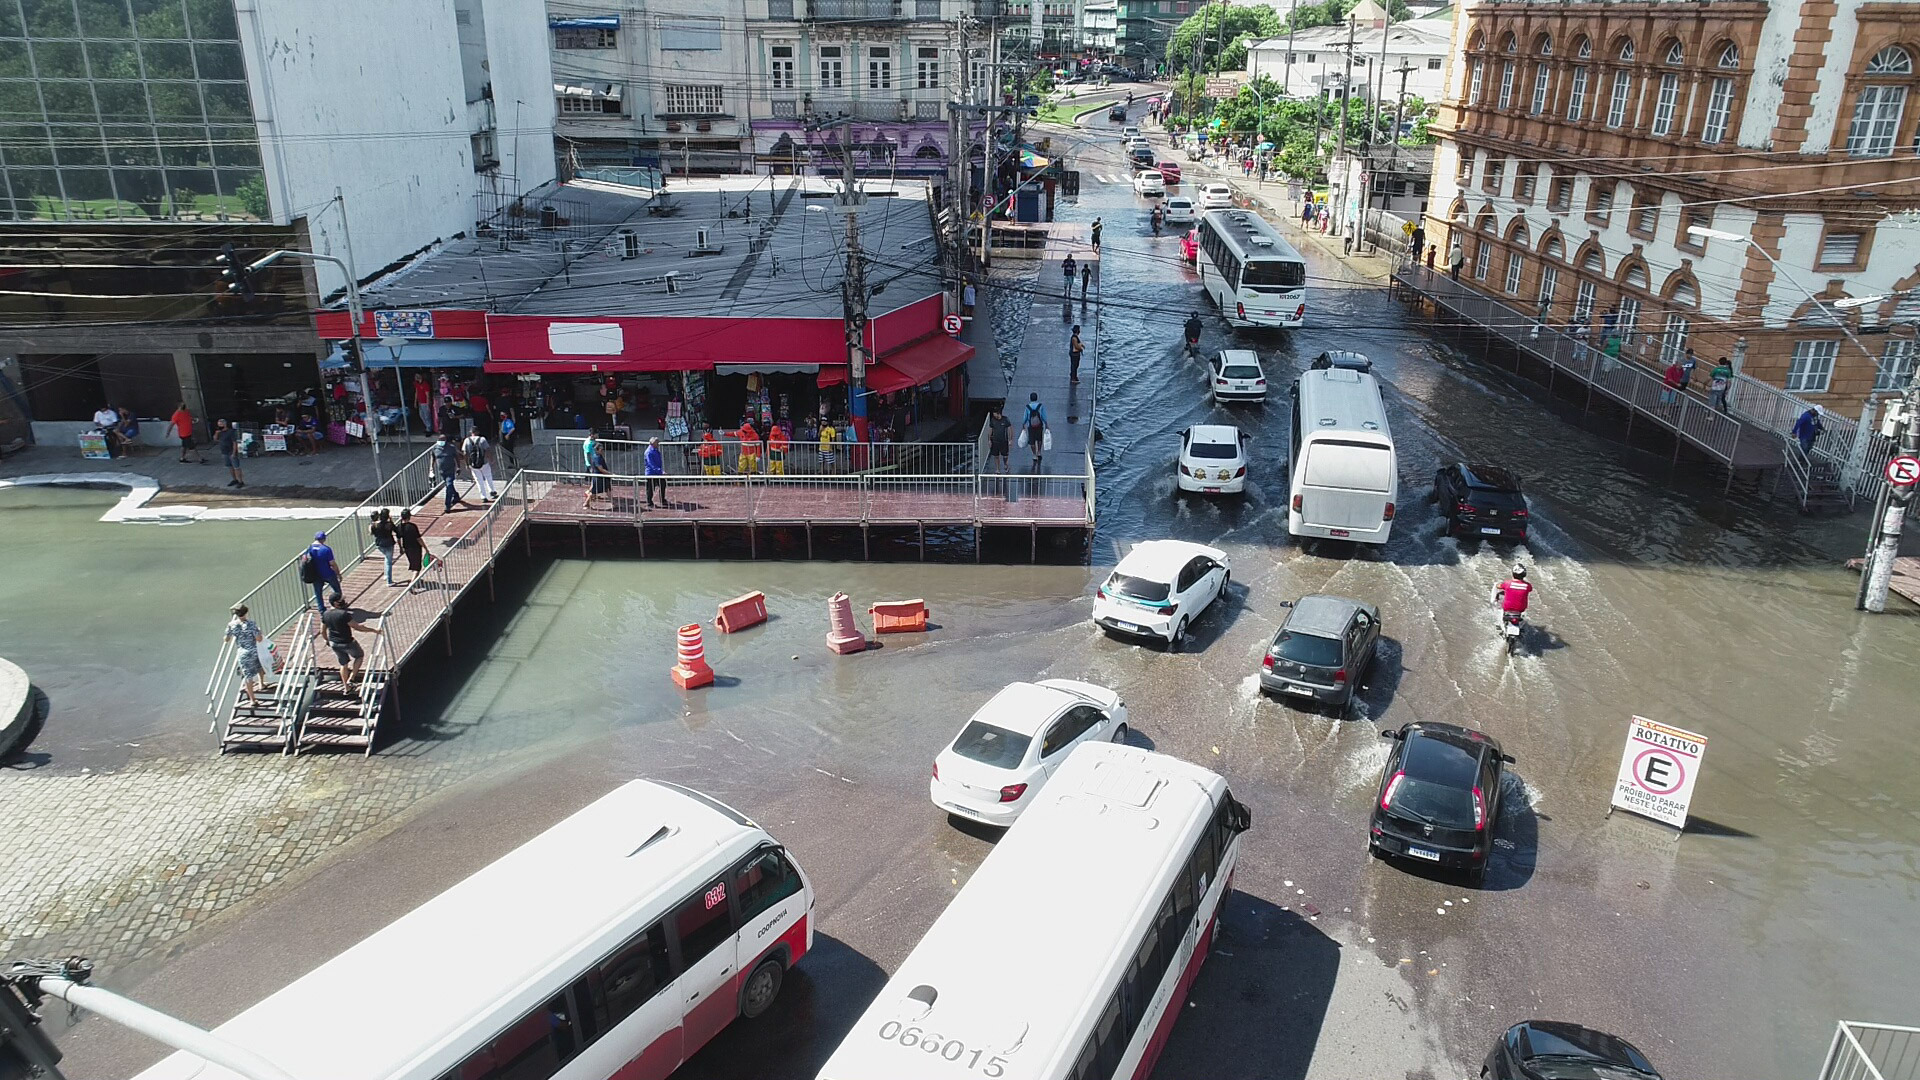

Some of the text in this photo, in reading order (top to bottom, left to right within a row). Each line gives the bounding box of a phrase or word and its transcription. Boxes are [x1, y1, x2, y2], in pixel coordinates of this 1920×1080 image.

[1895, 462, 1914, 479] E
[1636, 727, 1698, 754] ROTATIVO
[1645, 756, 1672, 788] E
[1619, 785, 1685, 812] PROIBIDO PARAR
[1624, 794, 1678, 817] NESTE LOCAL
[705, 882, 726, 910] 832
[878, 1020, 1009, 1078] 066015
